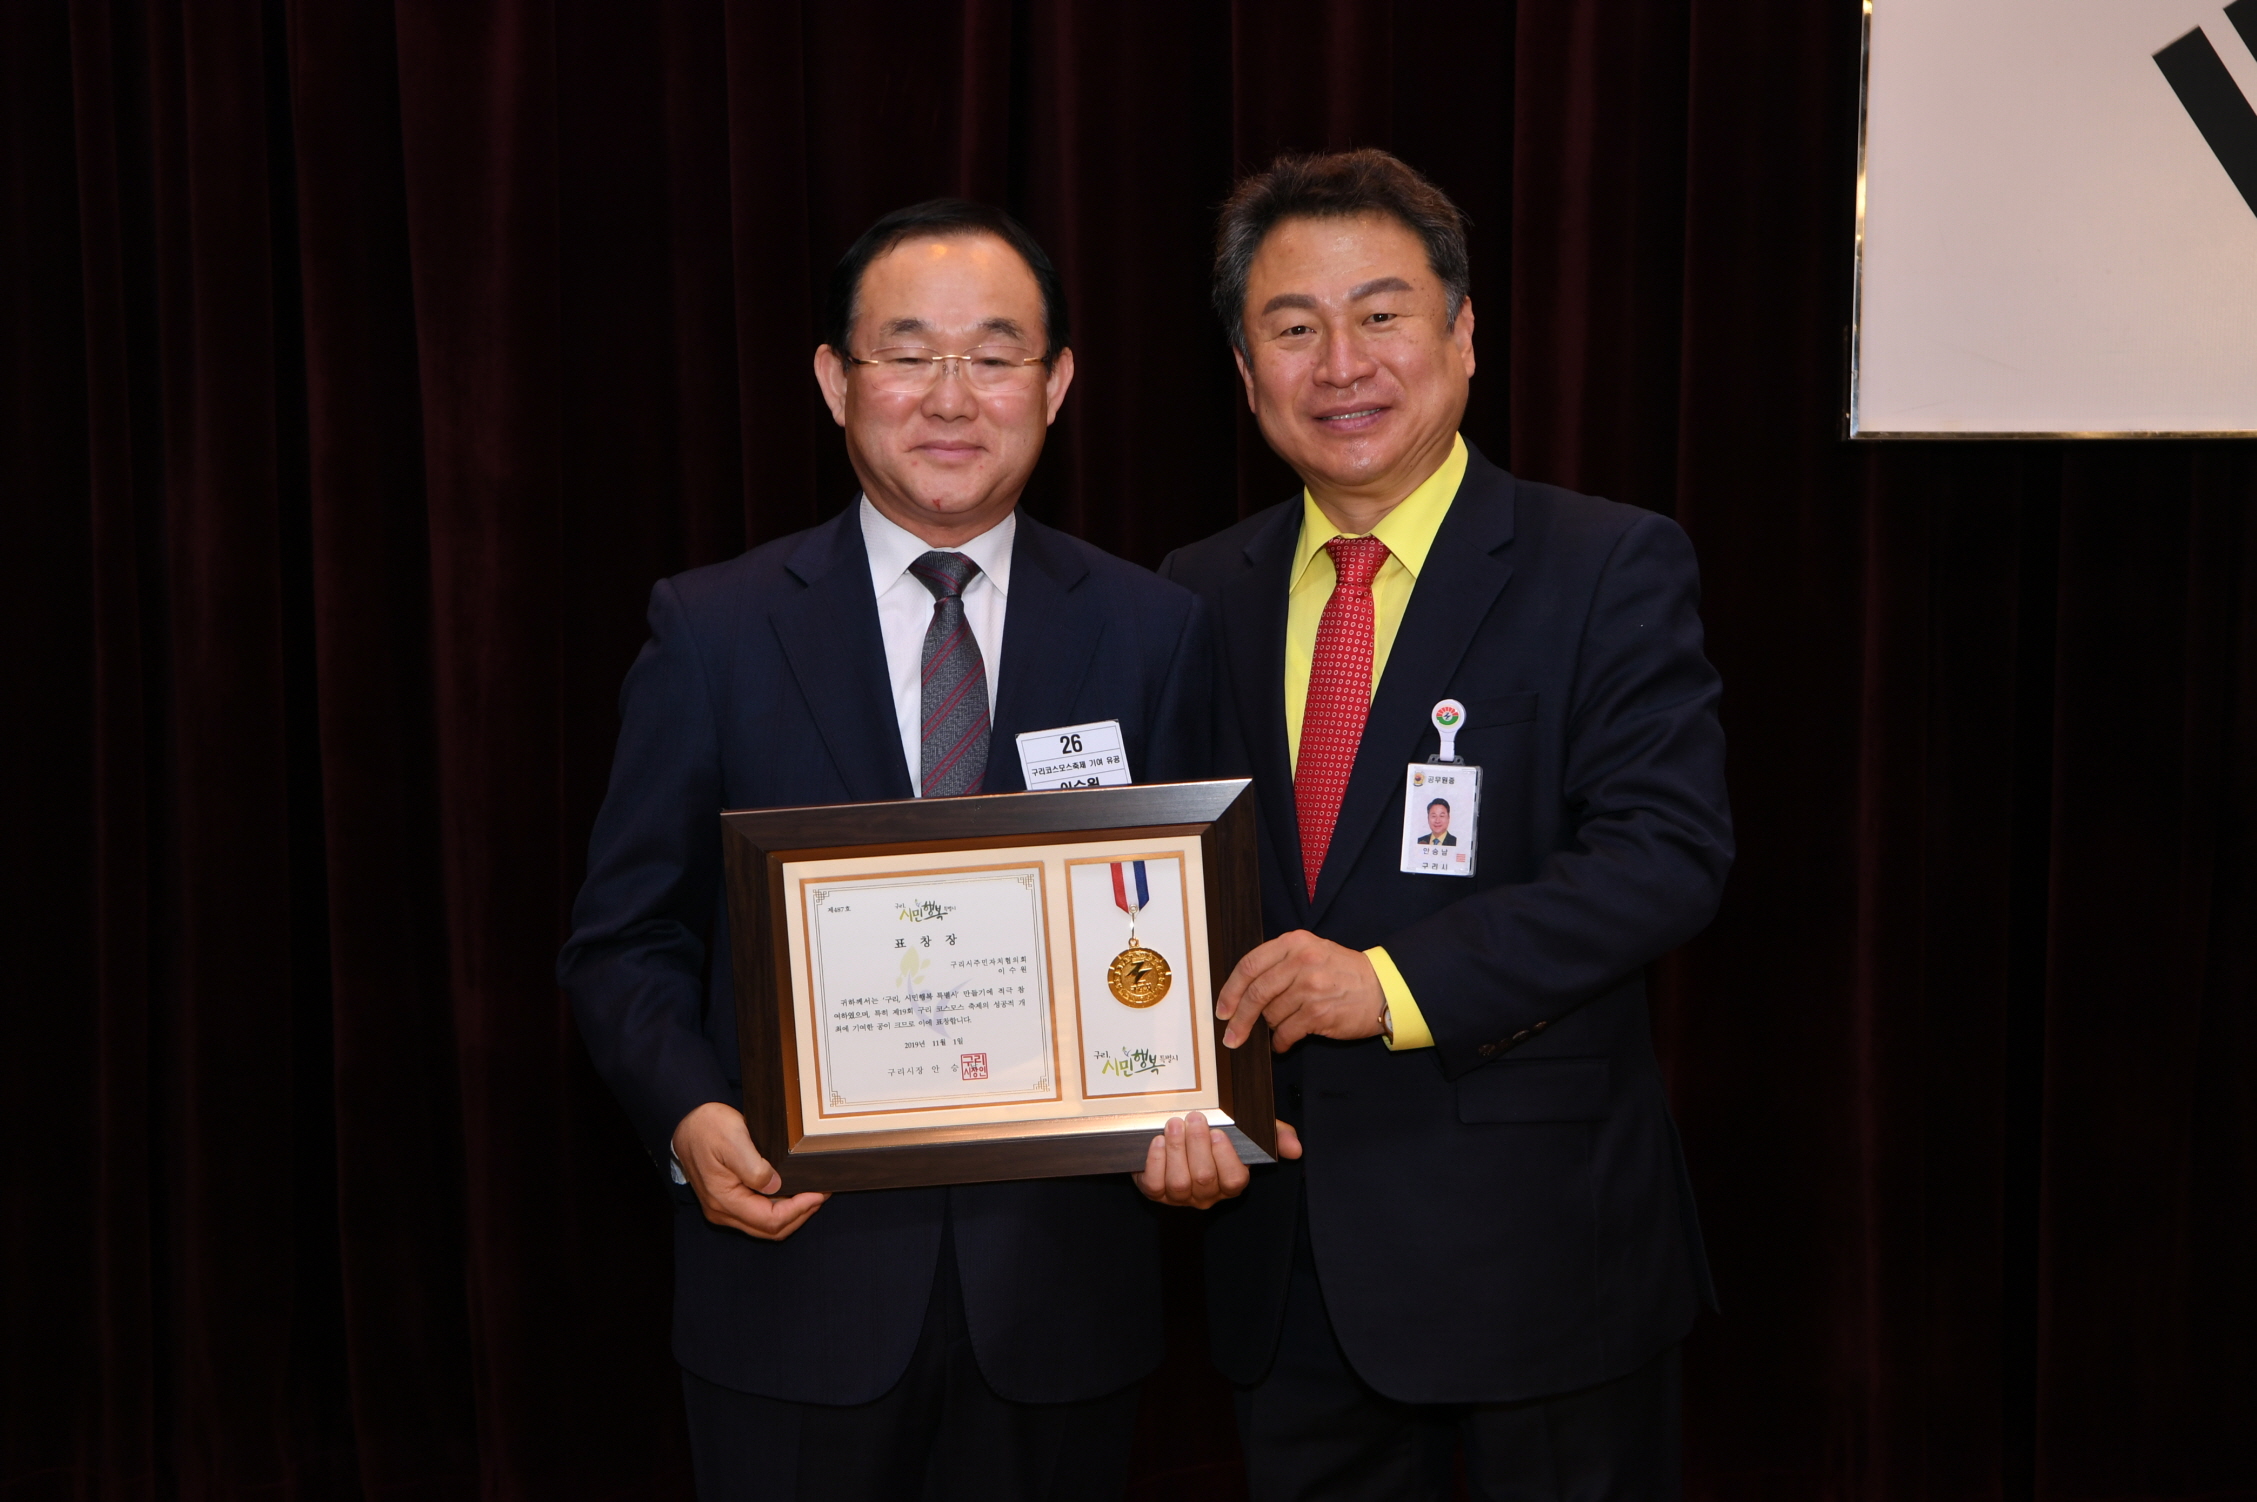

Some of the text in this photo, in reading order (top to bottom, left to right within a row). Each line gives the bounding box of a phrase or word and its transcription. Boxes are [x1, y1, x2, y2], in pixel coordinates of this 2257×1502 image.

[1060, 734, 1083, 754] 26
[1032, 755, 1120, 776] 구리코스모스축제 기여 유공
[899, 900, 948, 922] 시민행복
[950, 956, 1027, 969] 구리시주민자치협의회
[840, 997, 879, 1006] 귀하께서는
[892, 1007, 913, 1016] 제19회
[917, 1006, 932, 1014] 구리
[936, 1004, 964, 1012] 코스모스
[968, 1001, 989, 1010] 축제의
[852, 1023, 874, 1032] 기여한
[877, 1021, 891, 1031] 공이
[894, 1020, 915, 1028] 크므로
[918, 1019, 933, 1027] 이에
[904, 1037, 963, 1049] 2019년 11월 1일
[962, 1054, 985, 1067] 구리
[1102, 1048, 1166, 1077] 시민행복
[887, 1064, 924, 1077] 구리시장
[931, 1064, 940, 1074] 안
[951, 1063, 959, 1072] 승
[964, 1066, 986, 1078] 시장인
